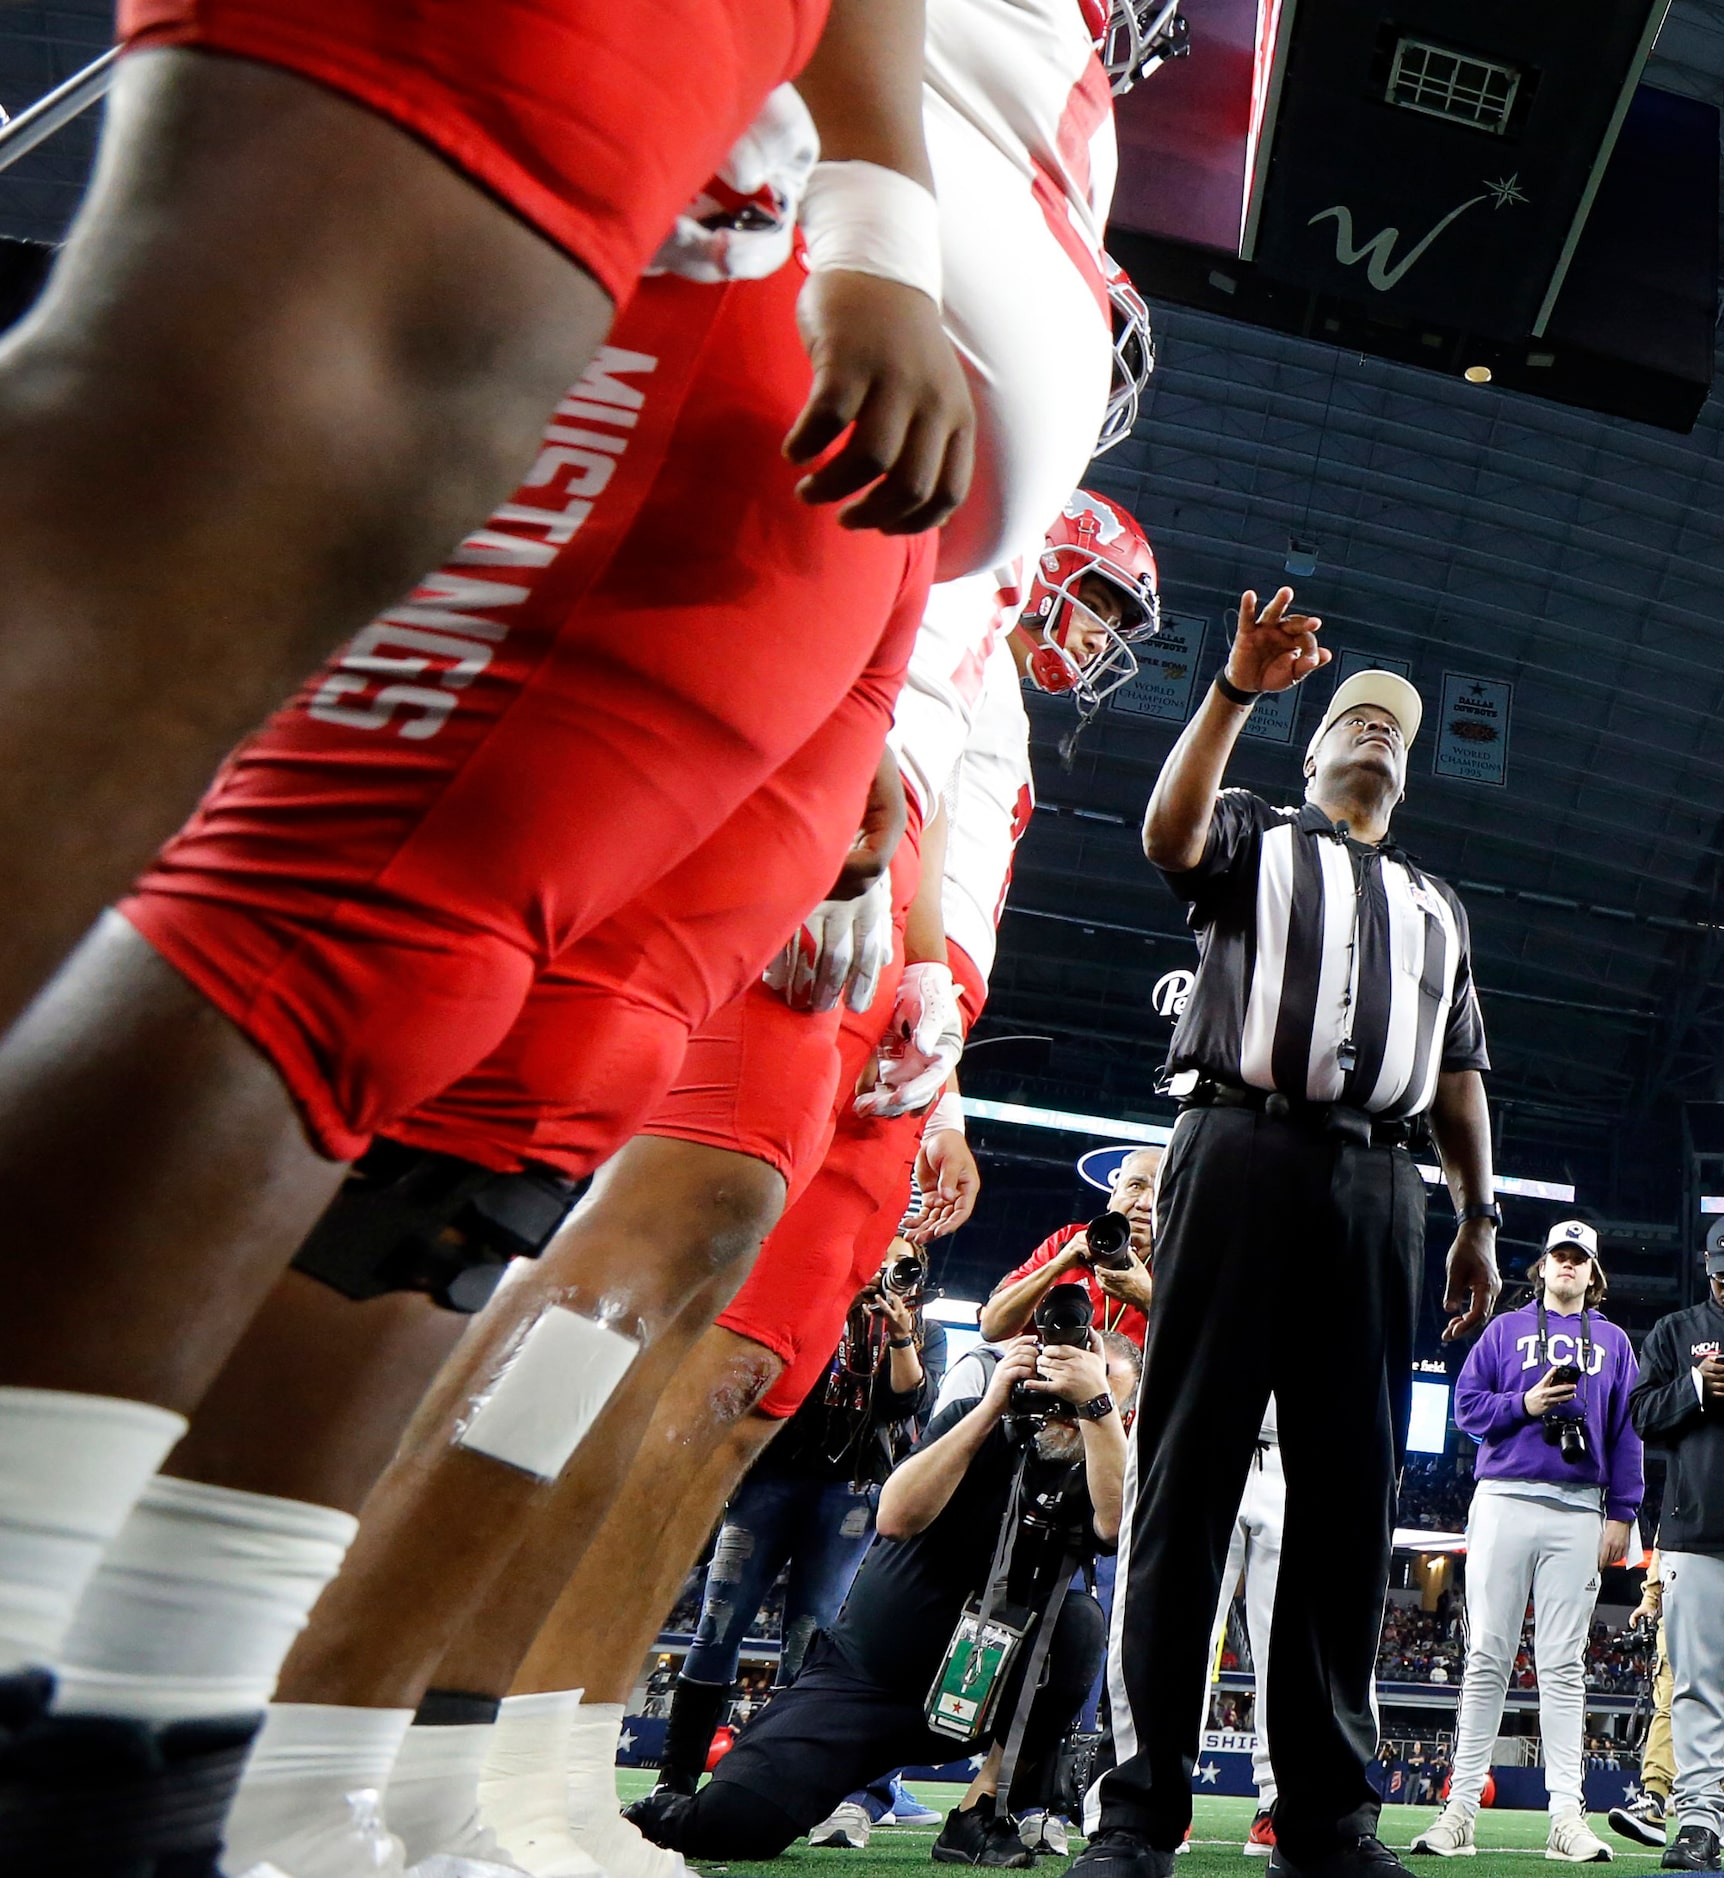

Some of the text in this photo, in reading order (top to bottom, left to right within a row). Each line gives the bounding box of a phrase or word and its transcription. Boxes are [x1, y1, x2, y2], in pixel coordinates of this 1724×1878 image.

[305, 344, 660, 741] MUSTANGS
[1134, 680, 1176, 697] WORLD
[1118, 687, 1186, 709] CHAMPIONS
[1458, 696, 1494, 709] DALLAS
[1138, 702, 1163, 715] 1977
[1250, 705, 1279, 718] ORLD
[1453, 704, 1498, 718] COWBOYS
[1453, 746, 1491, 761] WORLD
[1440, 754, 1502, 772] CHAMPIONS
[1459, 768, 1482, 778] 1995
[1516, 1333, 1607, 1377] TCU
